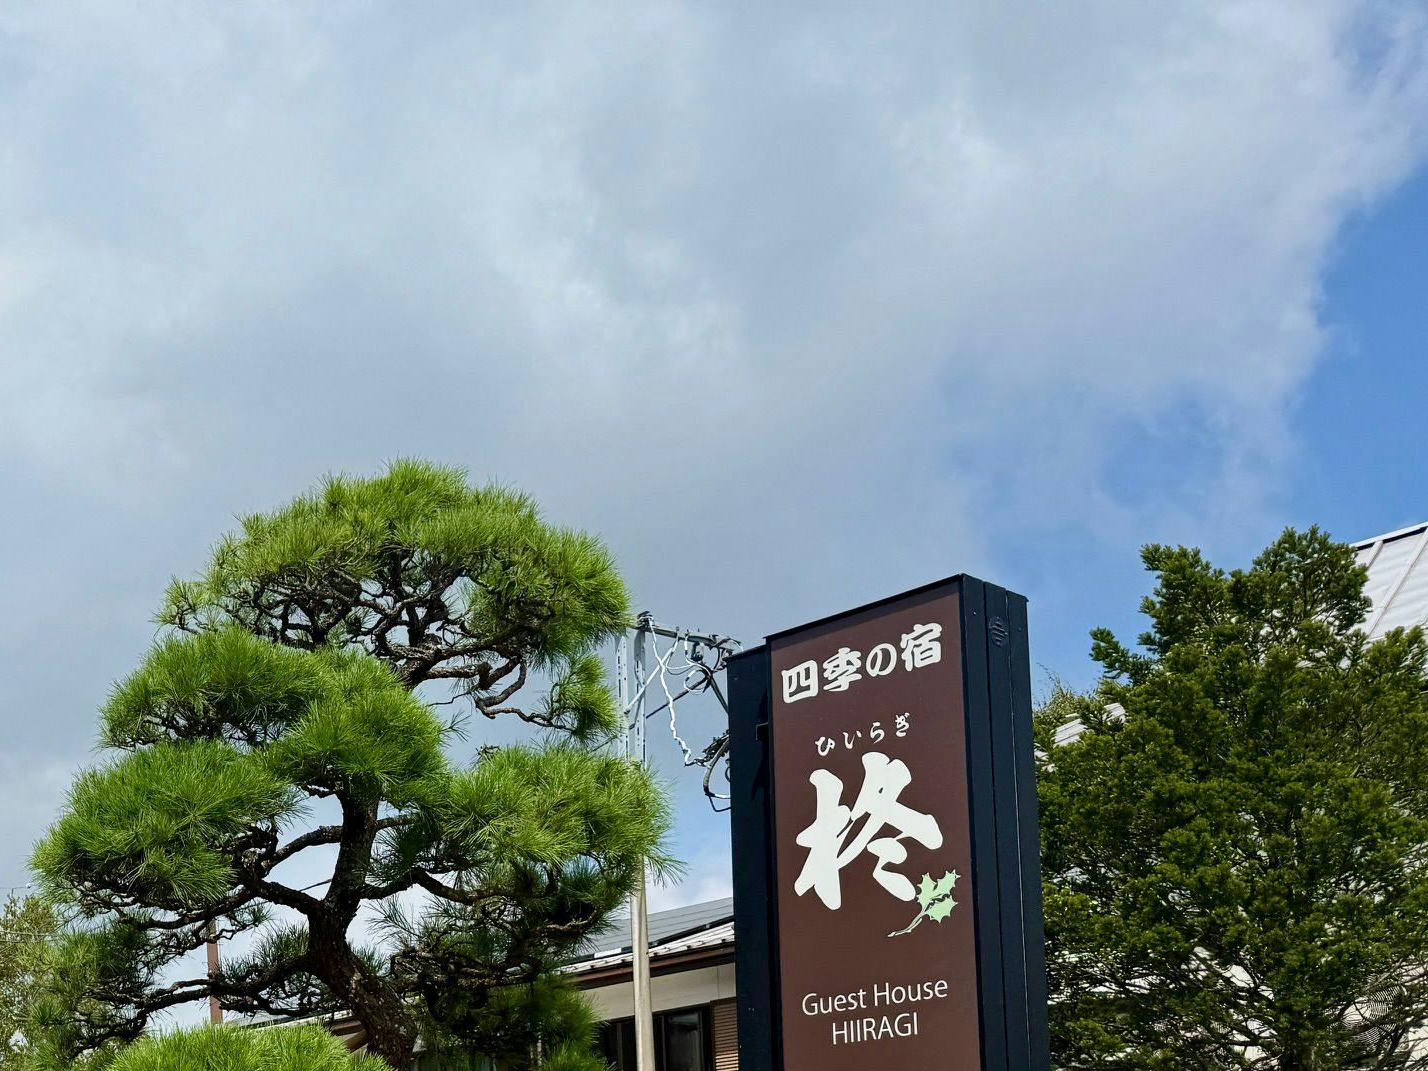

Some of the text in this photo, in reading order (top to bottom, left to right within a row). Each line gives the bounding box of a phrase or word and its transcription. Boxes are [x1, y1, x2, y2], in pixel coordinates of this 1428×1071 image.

[781, 622, 943, 703] 四季の宿
[815, 712, 910, 756] ひいらぎ
[794, 752, 943, 910] 柊
[802, 980, 948, 1016] Guest House
[832, 1013, 918, 1045] HIIRAGI
